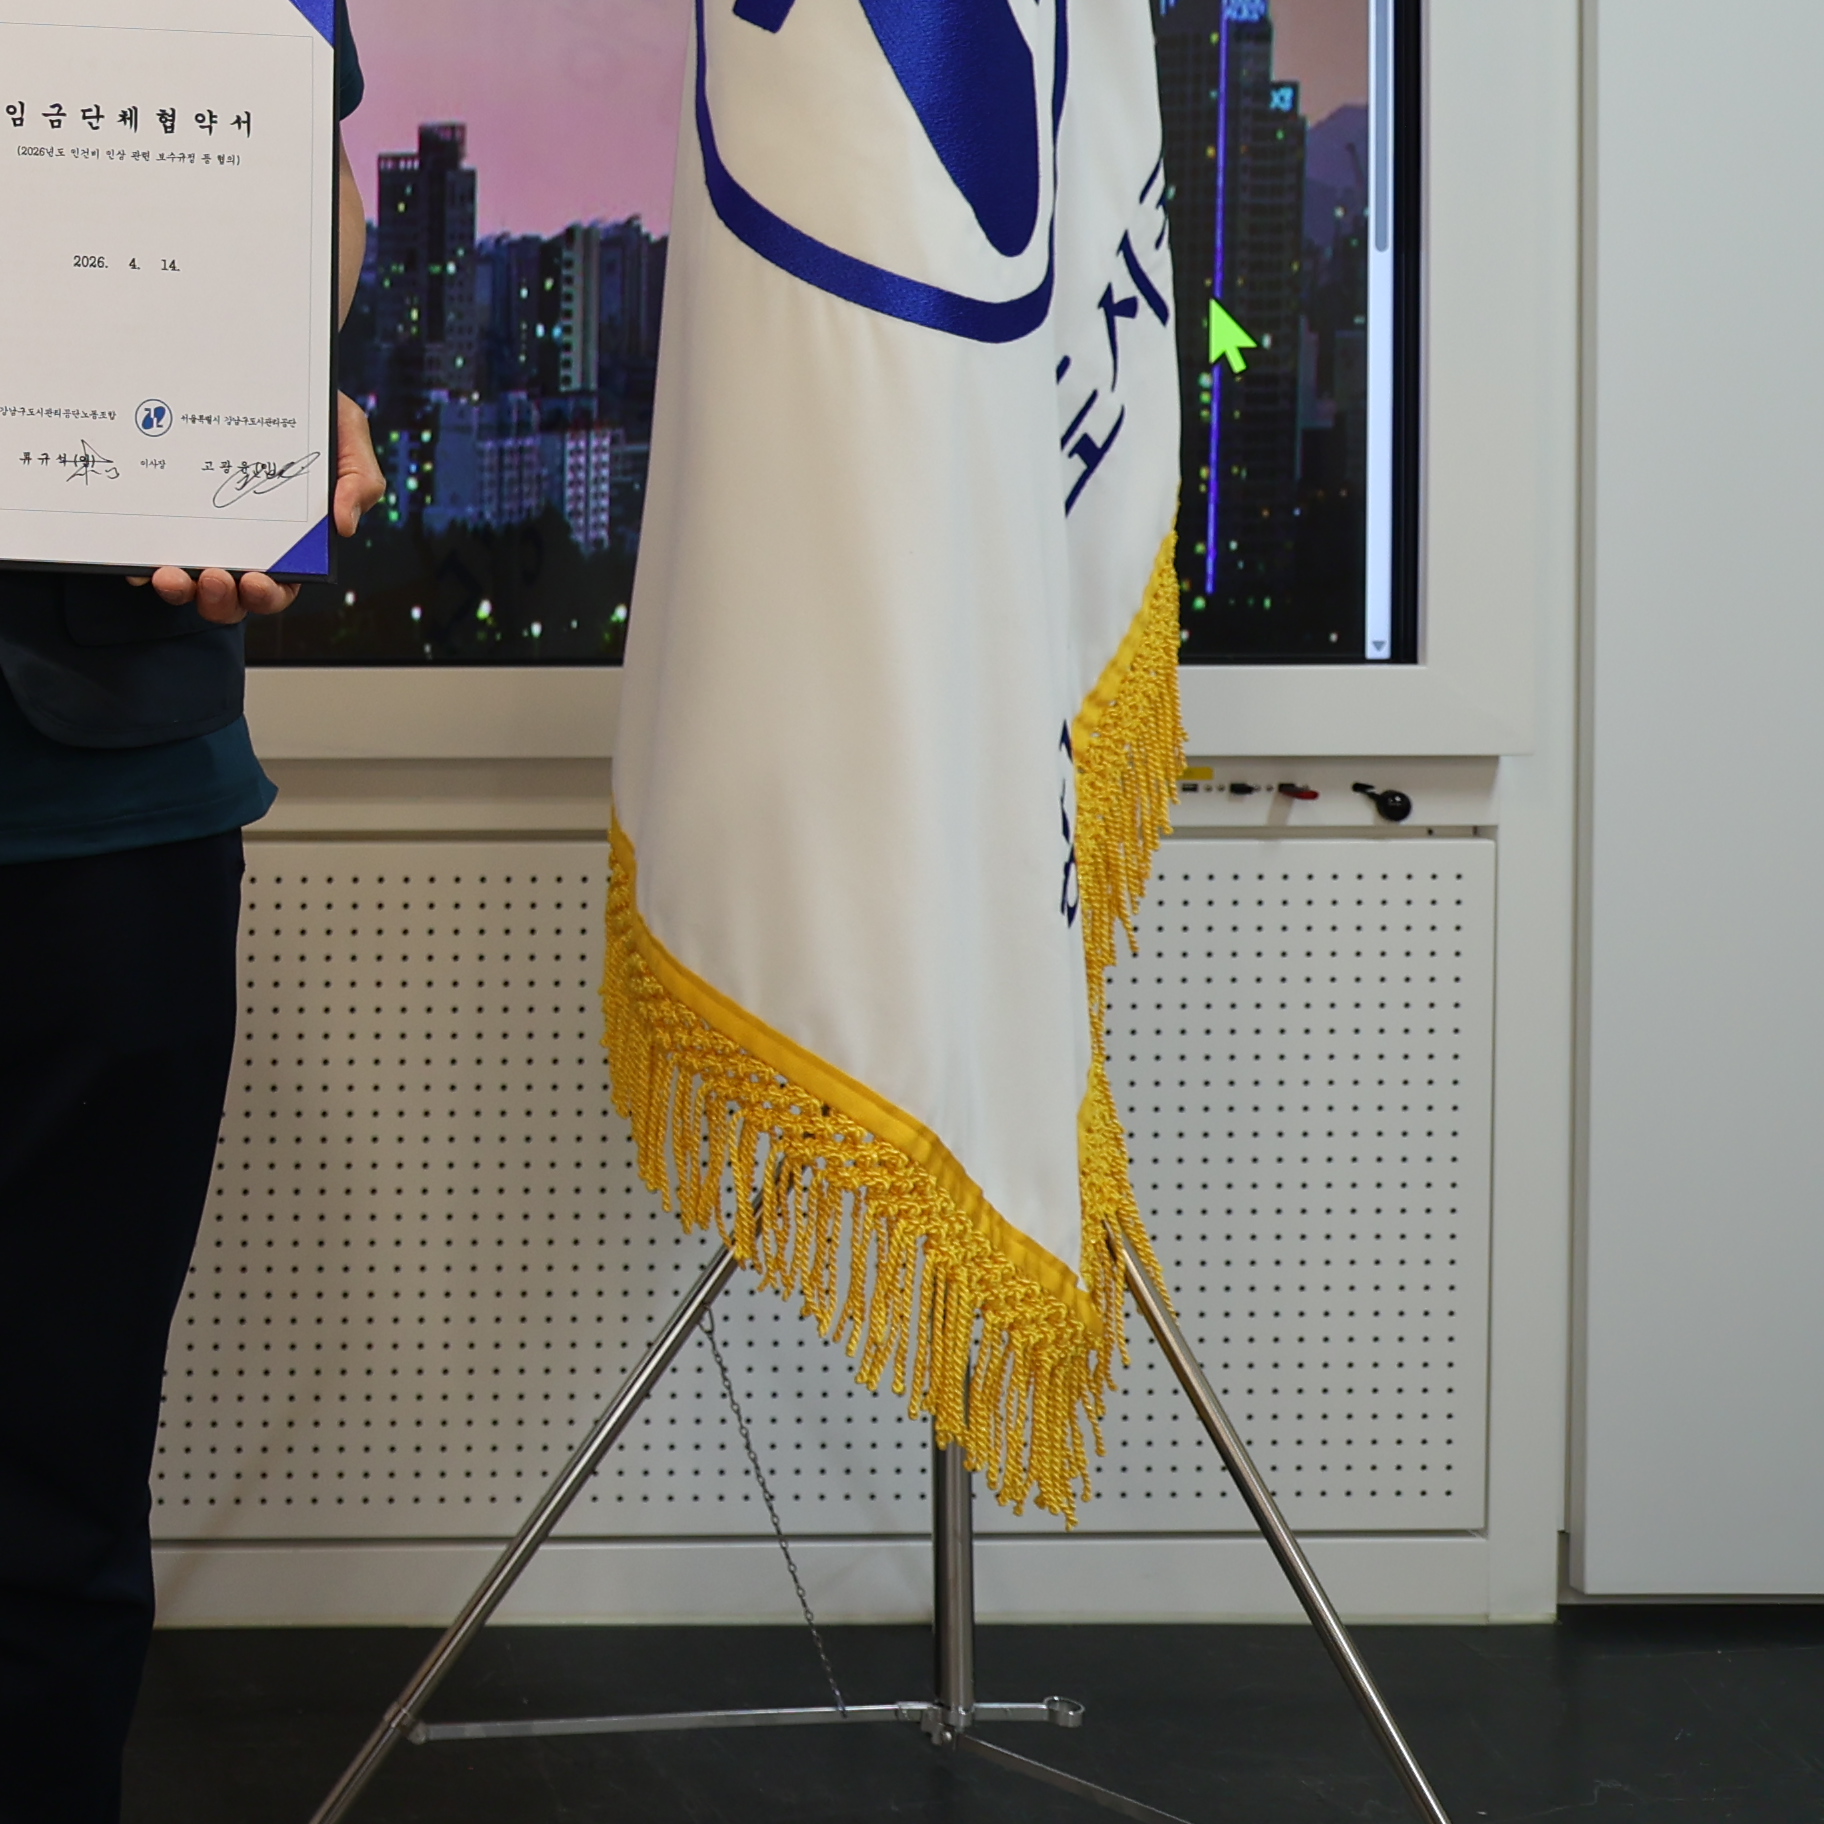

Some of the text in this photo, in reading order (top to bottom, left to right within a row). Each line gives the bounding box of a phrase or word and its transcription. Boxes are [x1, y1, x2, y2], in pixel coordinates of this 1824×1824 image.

[17, 146, 66, 157] (2026년도
[71, 147, 100, 160] 인건비
[106, 150, 126, 161] 인상
[73, 255, 181, 272] 2026. 4. 14.
